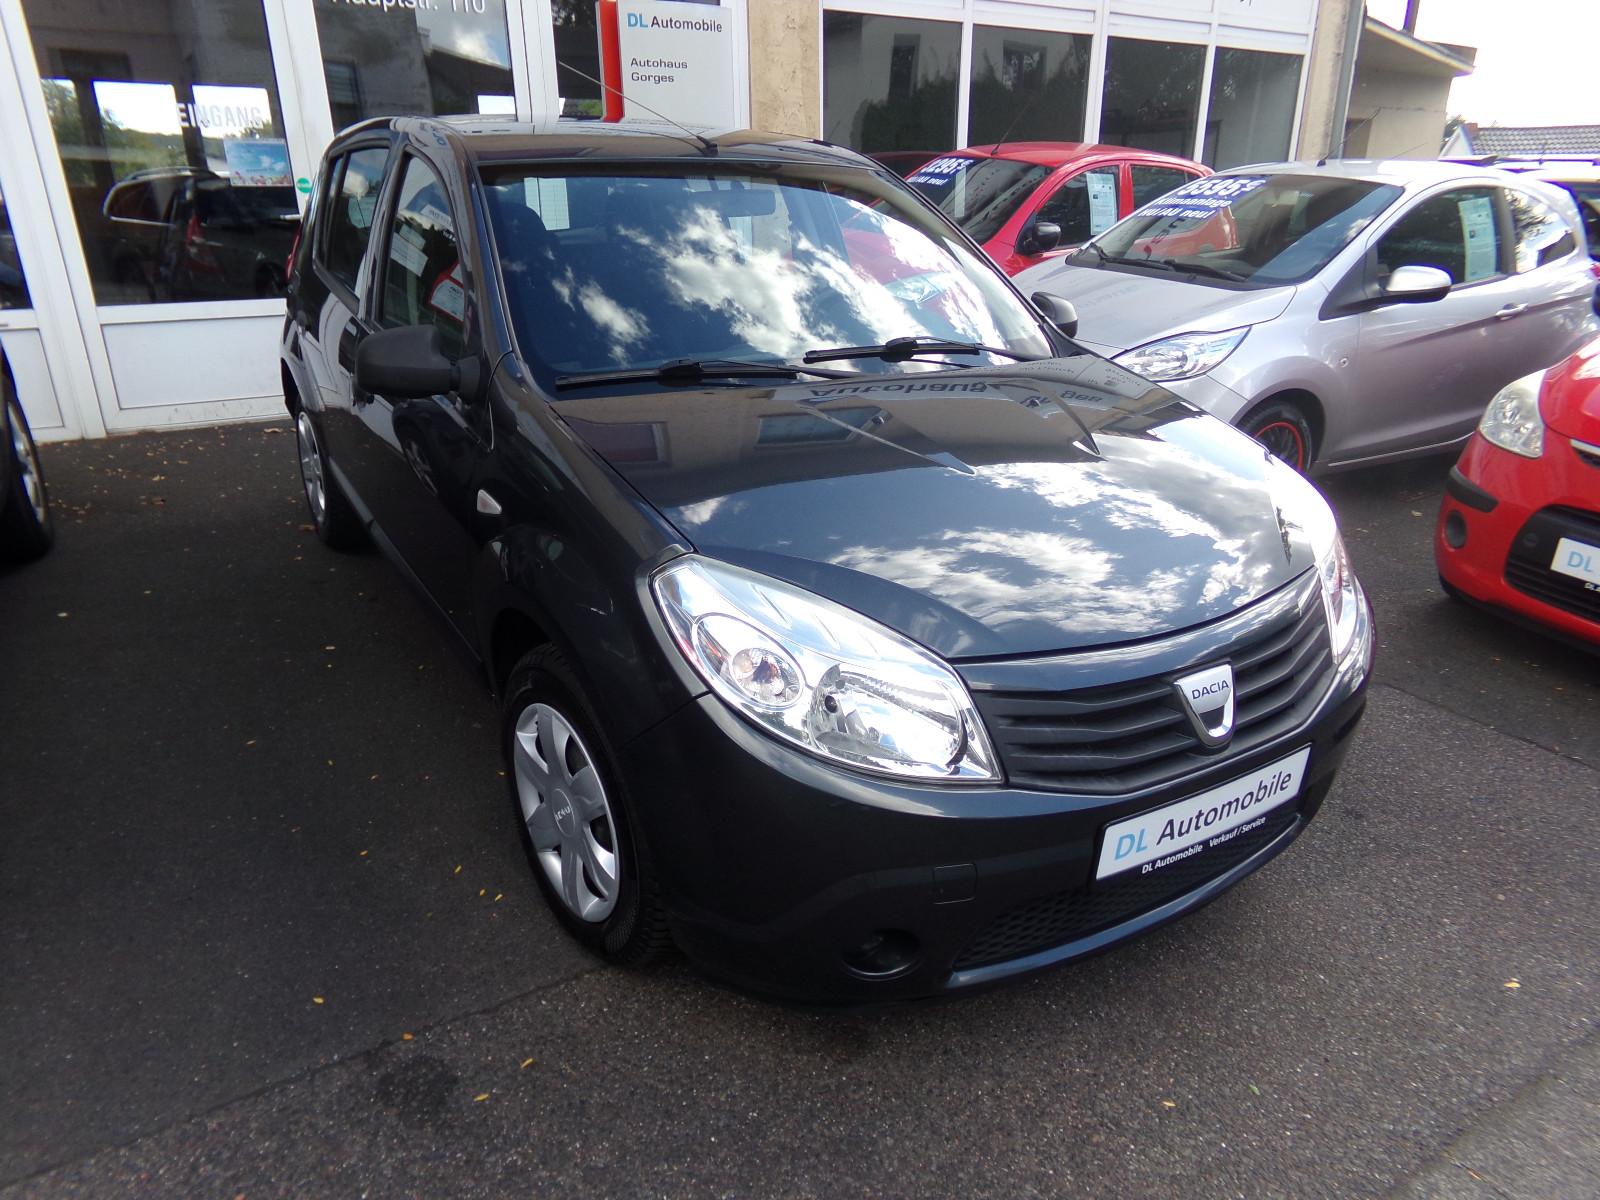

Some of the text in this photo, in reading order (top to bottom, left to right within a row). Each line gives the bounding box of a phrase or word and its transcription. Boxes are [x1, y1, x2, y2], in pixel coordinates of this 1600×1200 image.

[451, 0, 486, 13] 110
[626, 13, 722, 32] DL Automobile
[630, 57, 688, 69] Autohaus
[631, 71, 675, 85] Gorges
[176, 102, 265, 128] EINGANG
[1154, 197, 1233, 209] Klimaanlage
[1567, 551, 1593, 572] DL
[1191, 680, 1229, 699] DACIA
[1114, 770, 1292, 860] DL Automobile
[1141, 863, 1153, 874] DL
[1154, 844, 1203, 869] Automobile
